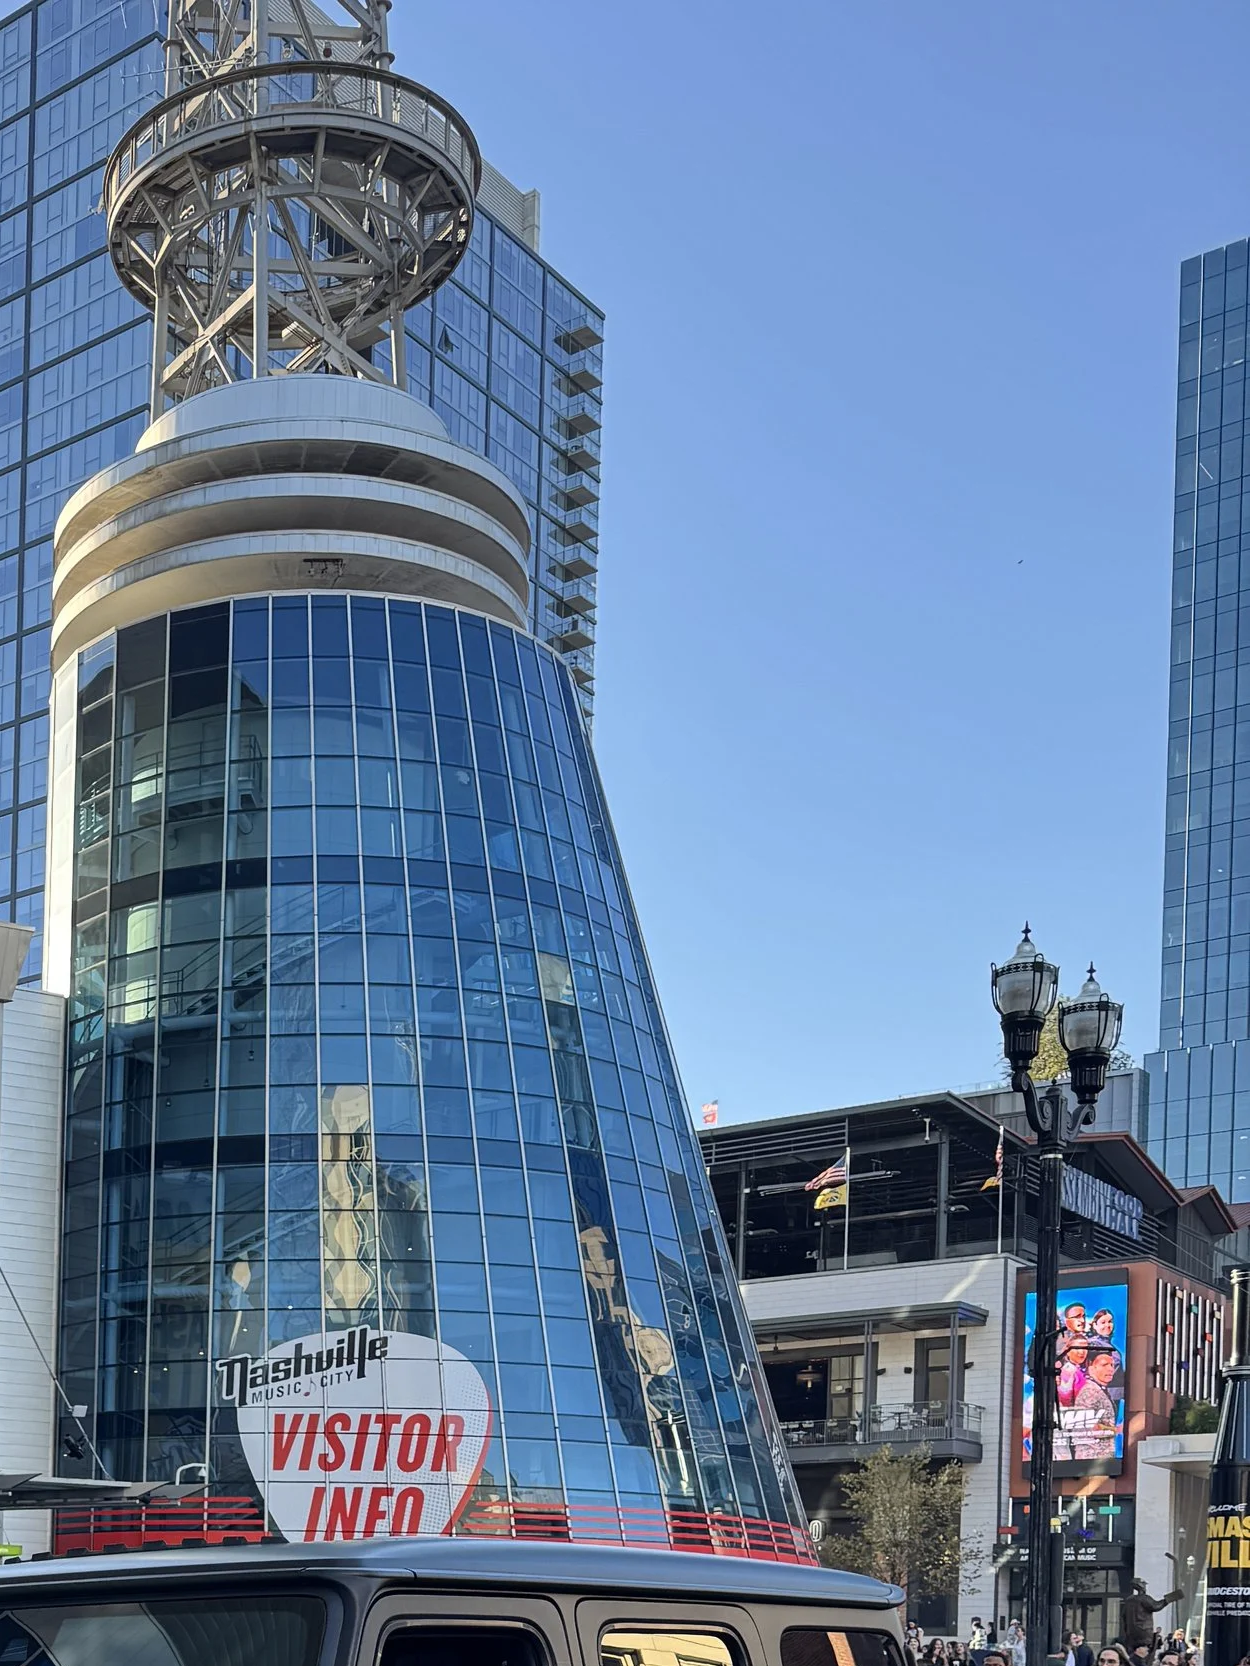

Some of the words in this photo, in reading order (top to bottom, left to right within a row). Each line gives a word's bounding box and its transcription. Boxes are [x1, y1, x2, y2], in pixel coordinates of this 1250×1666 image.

[218, 1326, 390, 1407] Nashville
[251, 1381, 302, 1404] MUSIC
[320, 1369, 354, 1388] CITY
[271, 1412, 466, 1473] VISITOR
[303, 1486, 426, 1542] INFO
